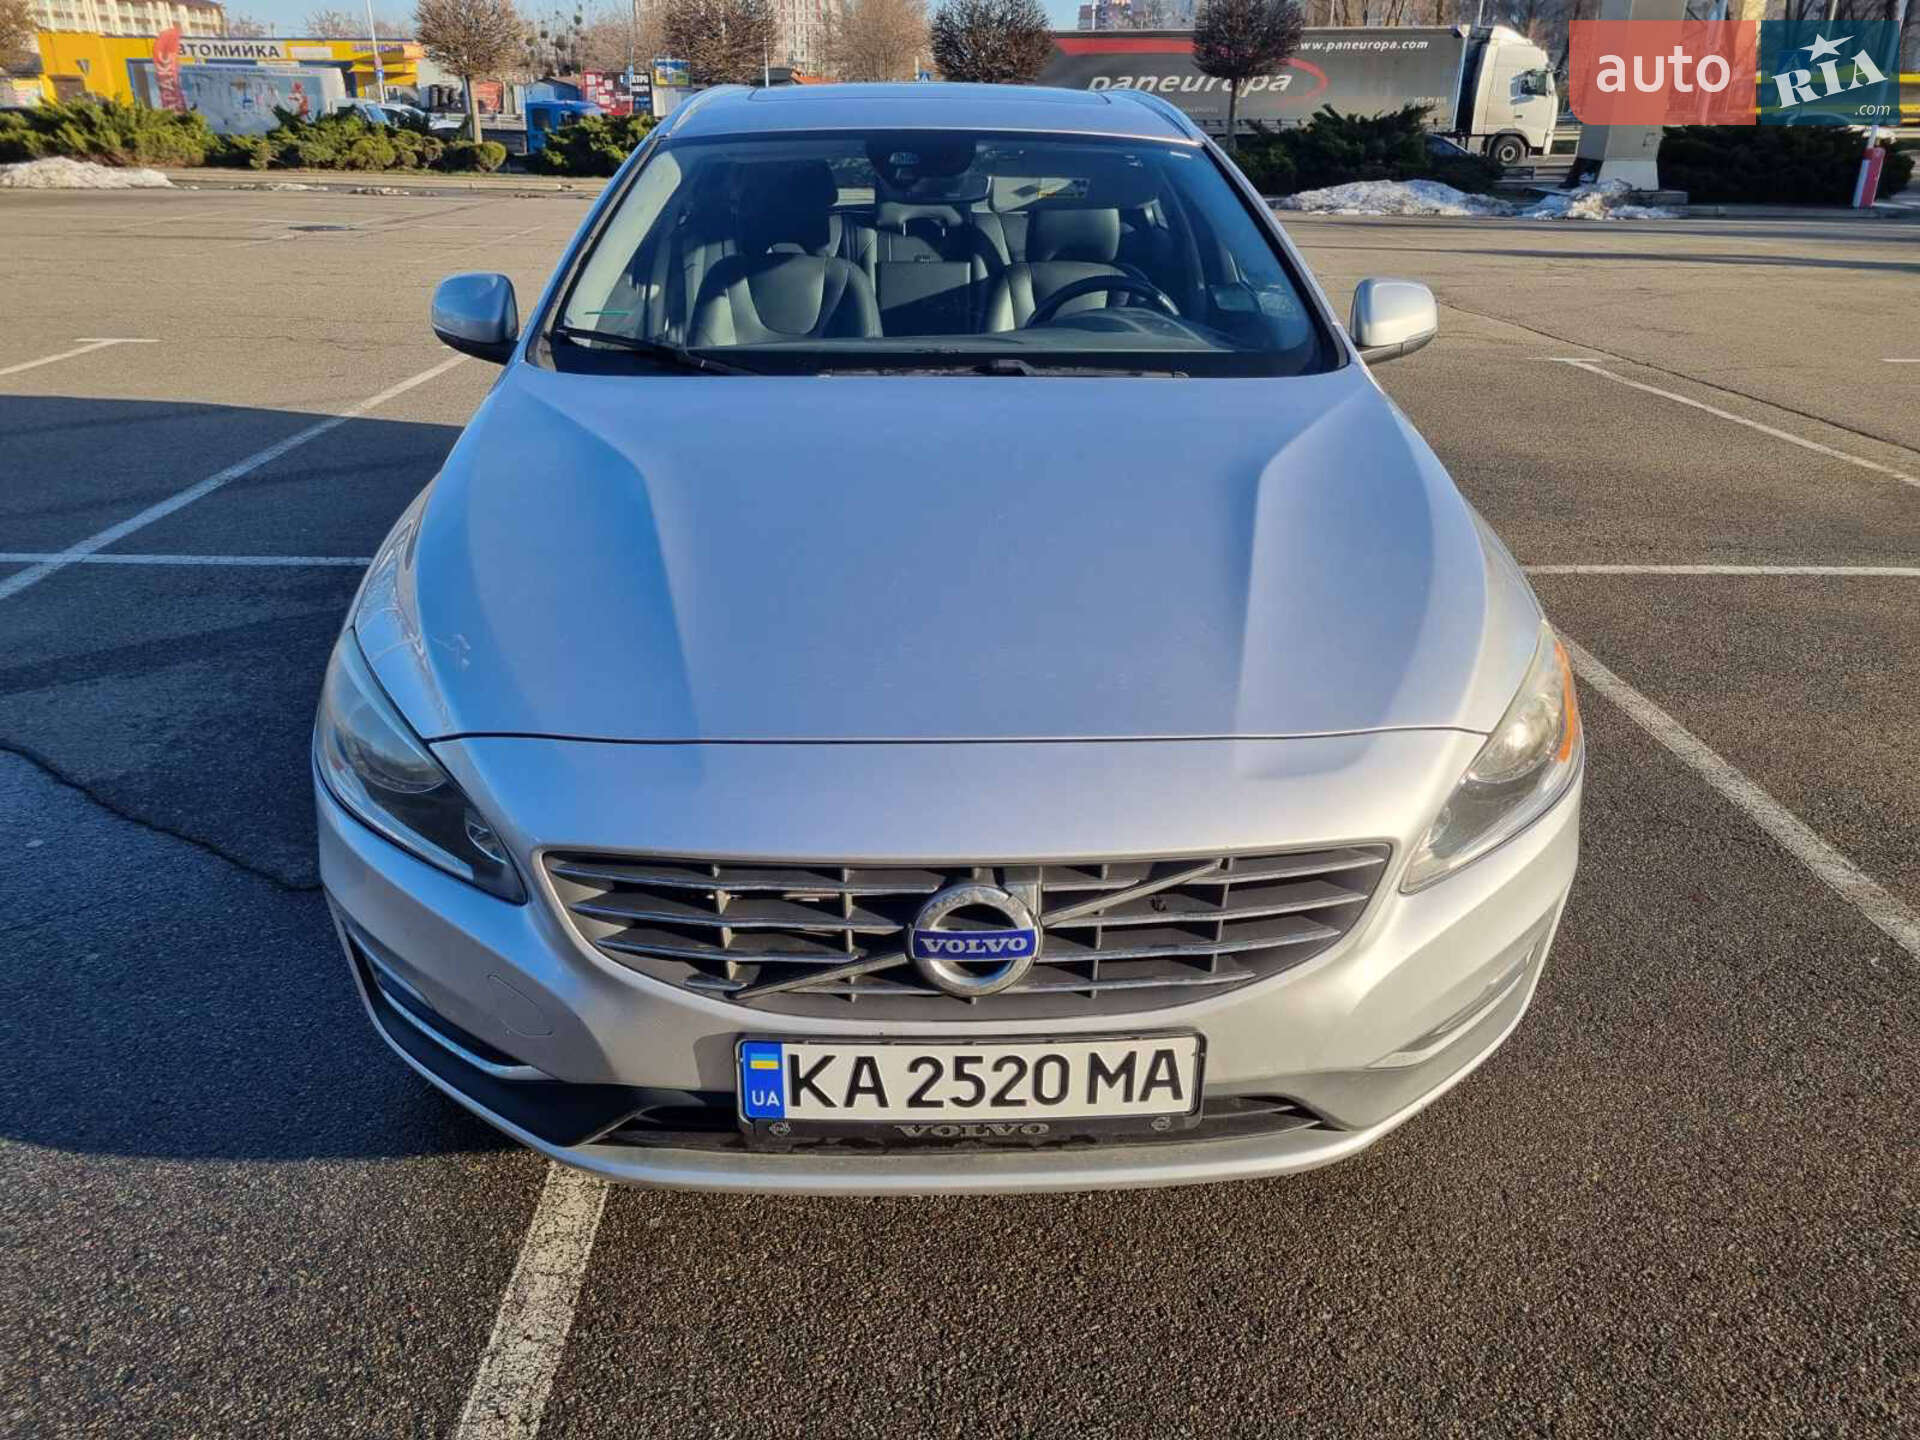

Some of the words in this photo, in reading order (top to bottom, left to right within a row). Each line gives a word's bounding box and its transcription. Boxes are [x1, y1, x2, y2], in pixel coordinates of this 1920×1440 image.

[177, 43, 280, 58] ВТОМИЙКА
[920, 937, 1028, 953] VOLVO
[787, 1053, 889, 1109] KA
[907, 1053, 1071, 1109] 2520
[1086, 1048, 1184, 1105] MA
[751, 1090, 780, 1107] UA
[894, 1122, 1050, 1138] VOLVO
